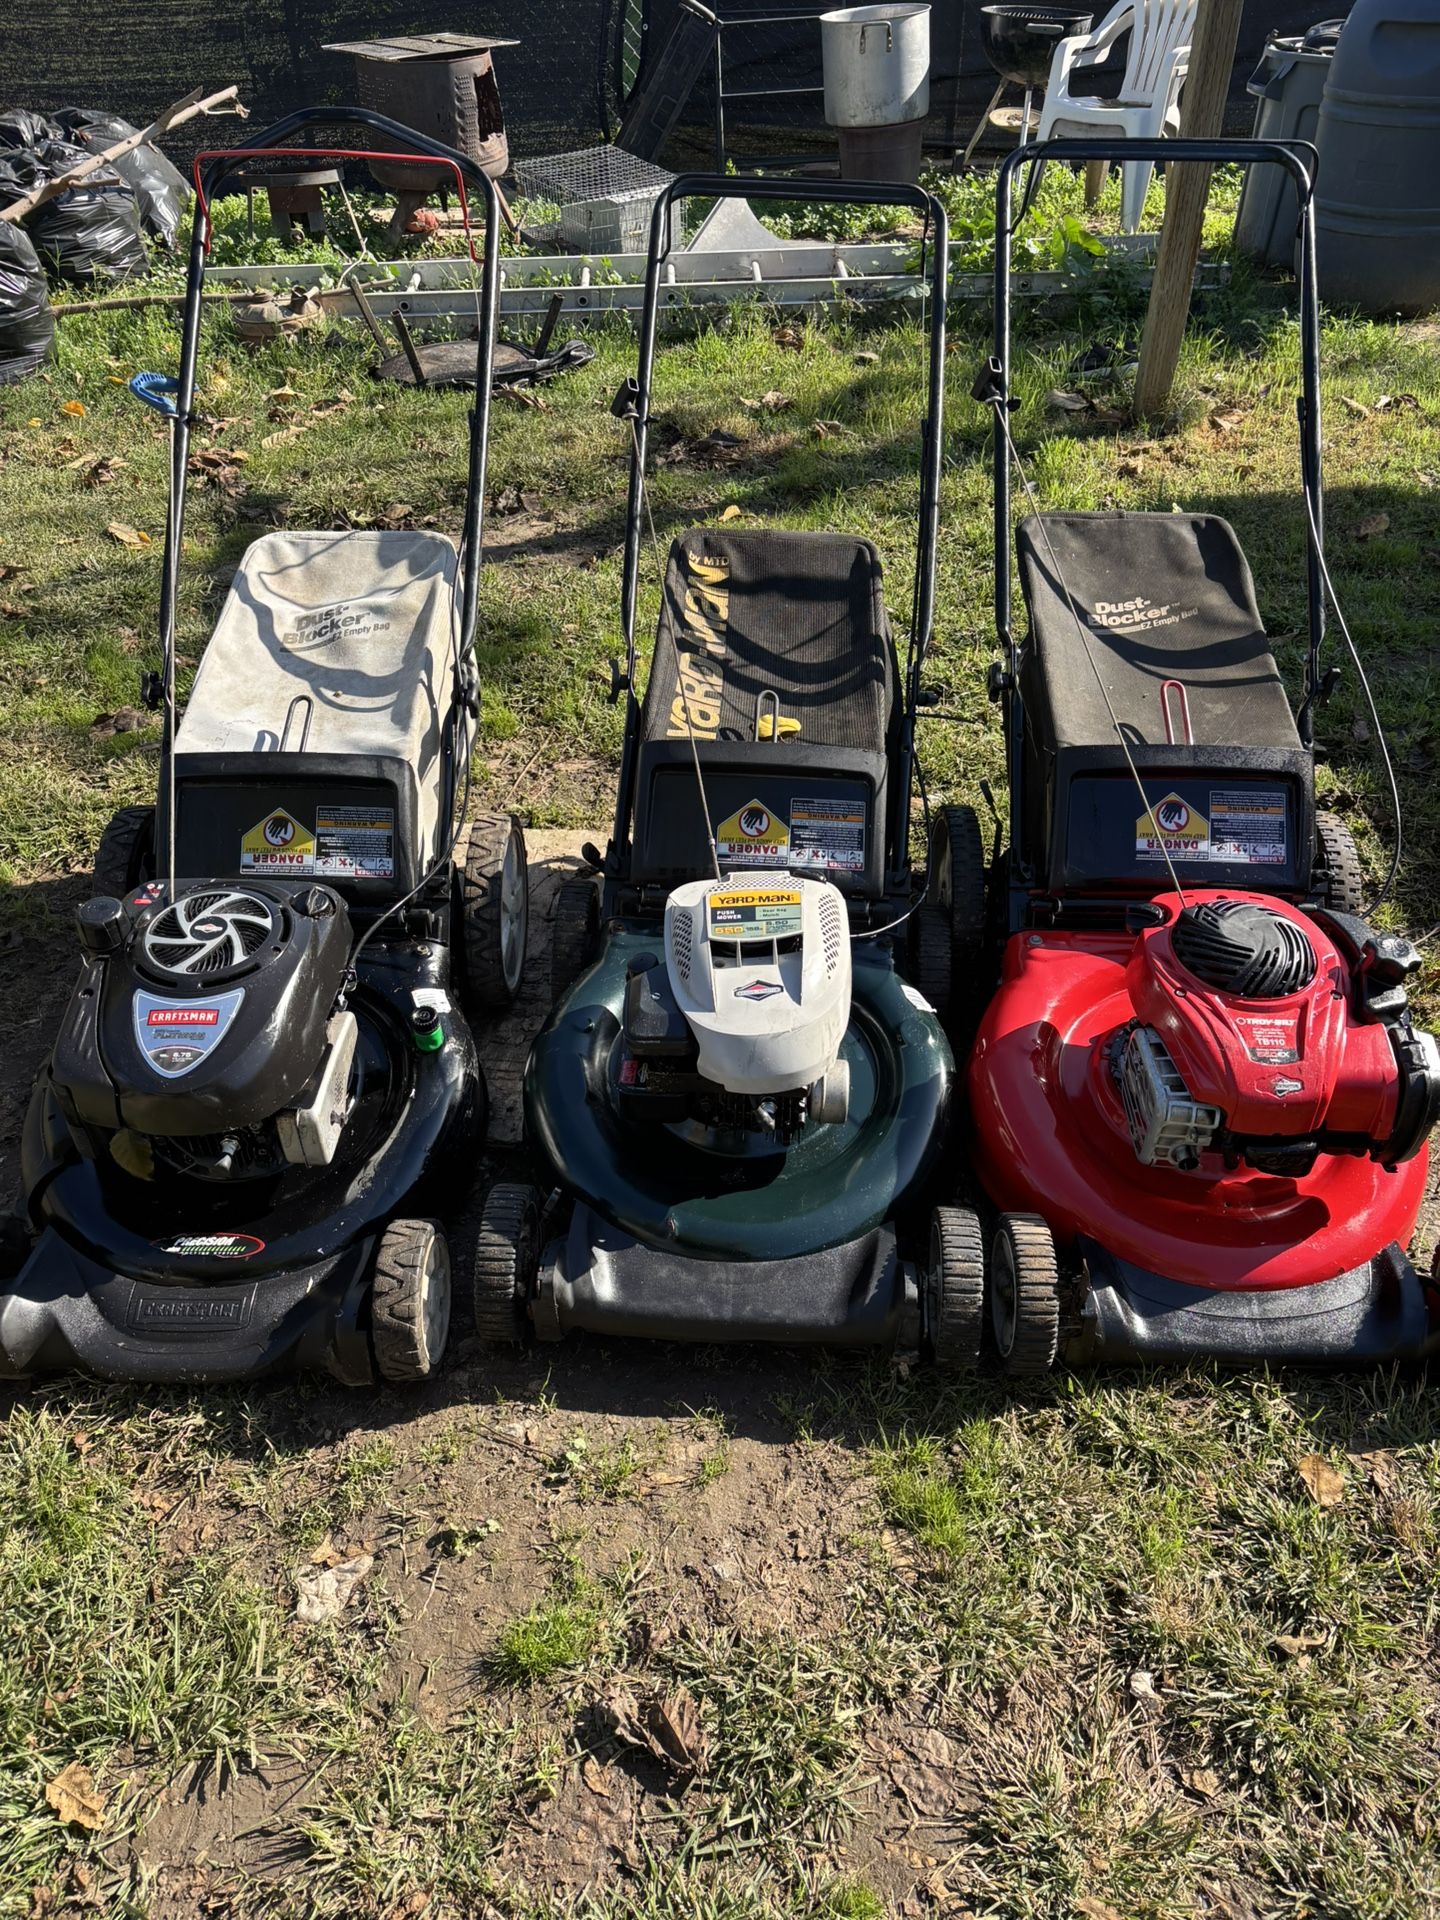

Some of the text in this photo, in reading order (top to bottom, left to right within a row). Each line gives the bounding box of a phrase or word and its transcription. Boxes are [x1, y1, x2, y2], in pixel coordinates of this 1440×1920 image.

[688, 551, 700, 563] by
[1095, 597, 1151, 614] Dust-
[294, 604, 350, 631] Dust-
[1140, 621, 1152, 630] EZ
[1153, 615, 1180, 627] Empty
[343, 625, 372, 636] Empty
[372, 622, 391, 633] Bag
[727, 844, 779, 855] DANGER
[1146, 839, 1199, 849] DANGER
[252, 854, 304, 864] DANGER
[151, 1012, 214, 1022] CRAFTSMAN
[1256, 1038, 1286, 1046] TB110
